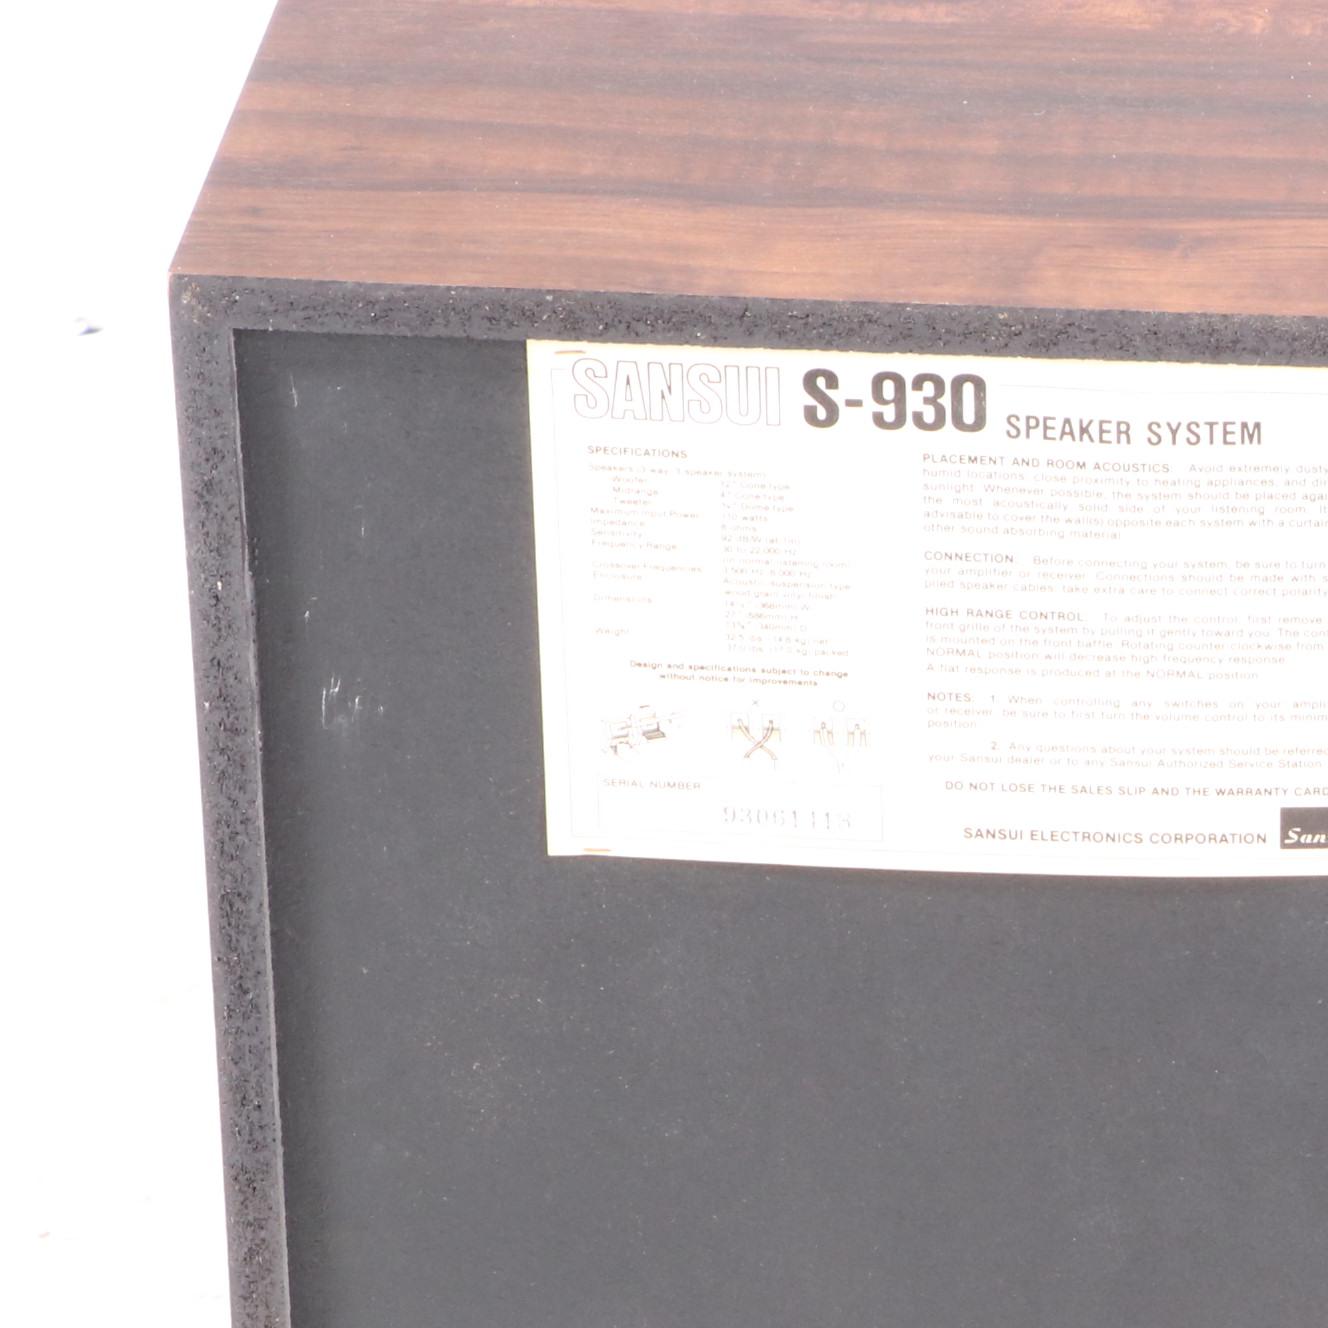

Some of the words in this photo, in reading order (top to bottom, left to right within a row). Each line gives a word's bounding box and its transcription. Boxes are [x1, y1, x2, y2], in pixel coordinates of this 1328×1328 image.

[571, 357, 781, 427] SANSUI
[802, 367, 987, 433] S-930
[1005, 413, 1132, 446] SPEAKER
[1146, 421, 1263, 446] SYSTEM
[587, 445, 689, 460] SPECIFICATIONS
[921, 454, 1004, 469] PLACEMENT
[1011, 459, 1040, 470] AND
[1046, 460, 1087, 471] ROOM
[1186, 464, 1223, 474] Avoid
[1228, 464, 1289, 477] extremely
[1298, 464, 1328, 477] dusty
[924, 606, 959, 618] HIGH
[966, 608, 1013, 620] RANGE
[603, 777, 645, 790] SERIAL
[649, 781, 702, 792] NUMBER
[968, 781, 995, 792] NOT
[1001, 782, 1035, 793] LOSE
[1040, 783, 1065, 794] THE
[1071, 784, 1113, 795] SALES
[1117, 785, 1146, 796] SLIP
[1151, 786, 1180, 796] AND
[1185, 786, 1209, 796] THE
[1215, 786, 1289, 796] WARRANTY
[963, 827, 1023, 843] SANSUI
[1029, 829, 1144, 846] ELECTRONICS
[1149, 832, 1269, 846] CORPORATION
